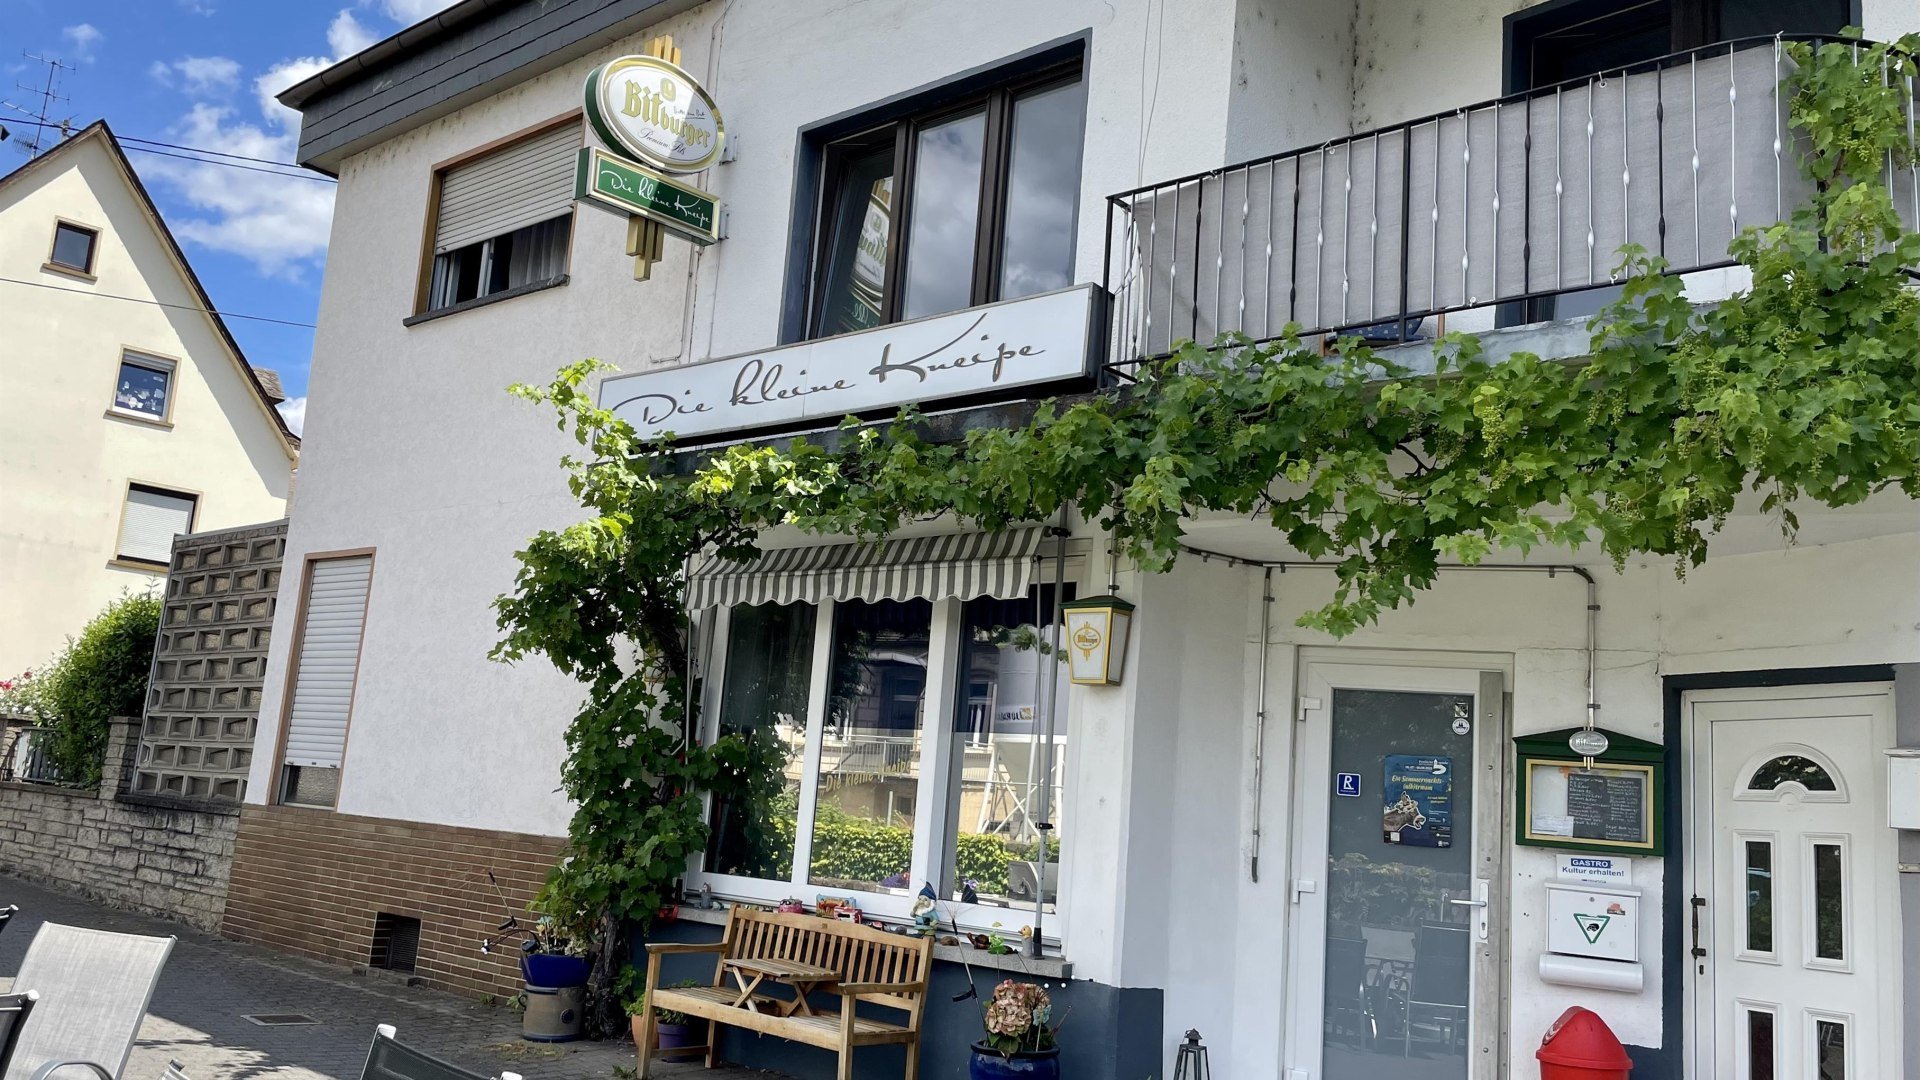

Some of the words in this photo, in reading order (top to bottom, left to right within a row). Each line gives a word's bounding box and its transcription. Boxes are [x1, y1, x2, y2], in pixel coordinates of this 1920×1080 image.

[621, 79, 711, 149] Bitburger
[640, 128, 670, 148] Premium
[601, 170, 634, 194] Die
[638, 177, 672, 208] kleine
[674, 194, 710, 228] Kneipe
[612, 388, 714, 426] Die
[728, 358, 857, 407] kleine
[868, 312, 1047, 383] Kneipe
[825, 773, 842, 793] Die
[845, 770, 874, 788] kleine
[1562, 866, 1587, 875] Kultur
[1588, 868, 1625, 877] erhalten!
